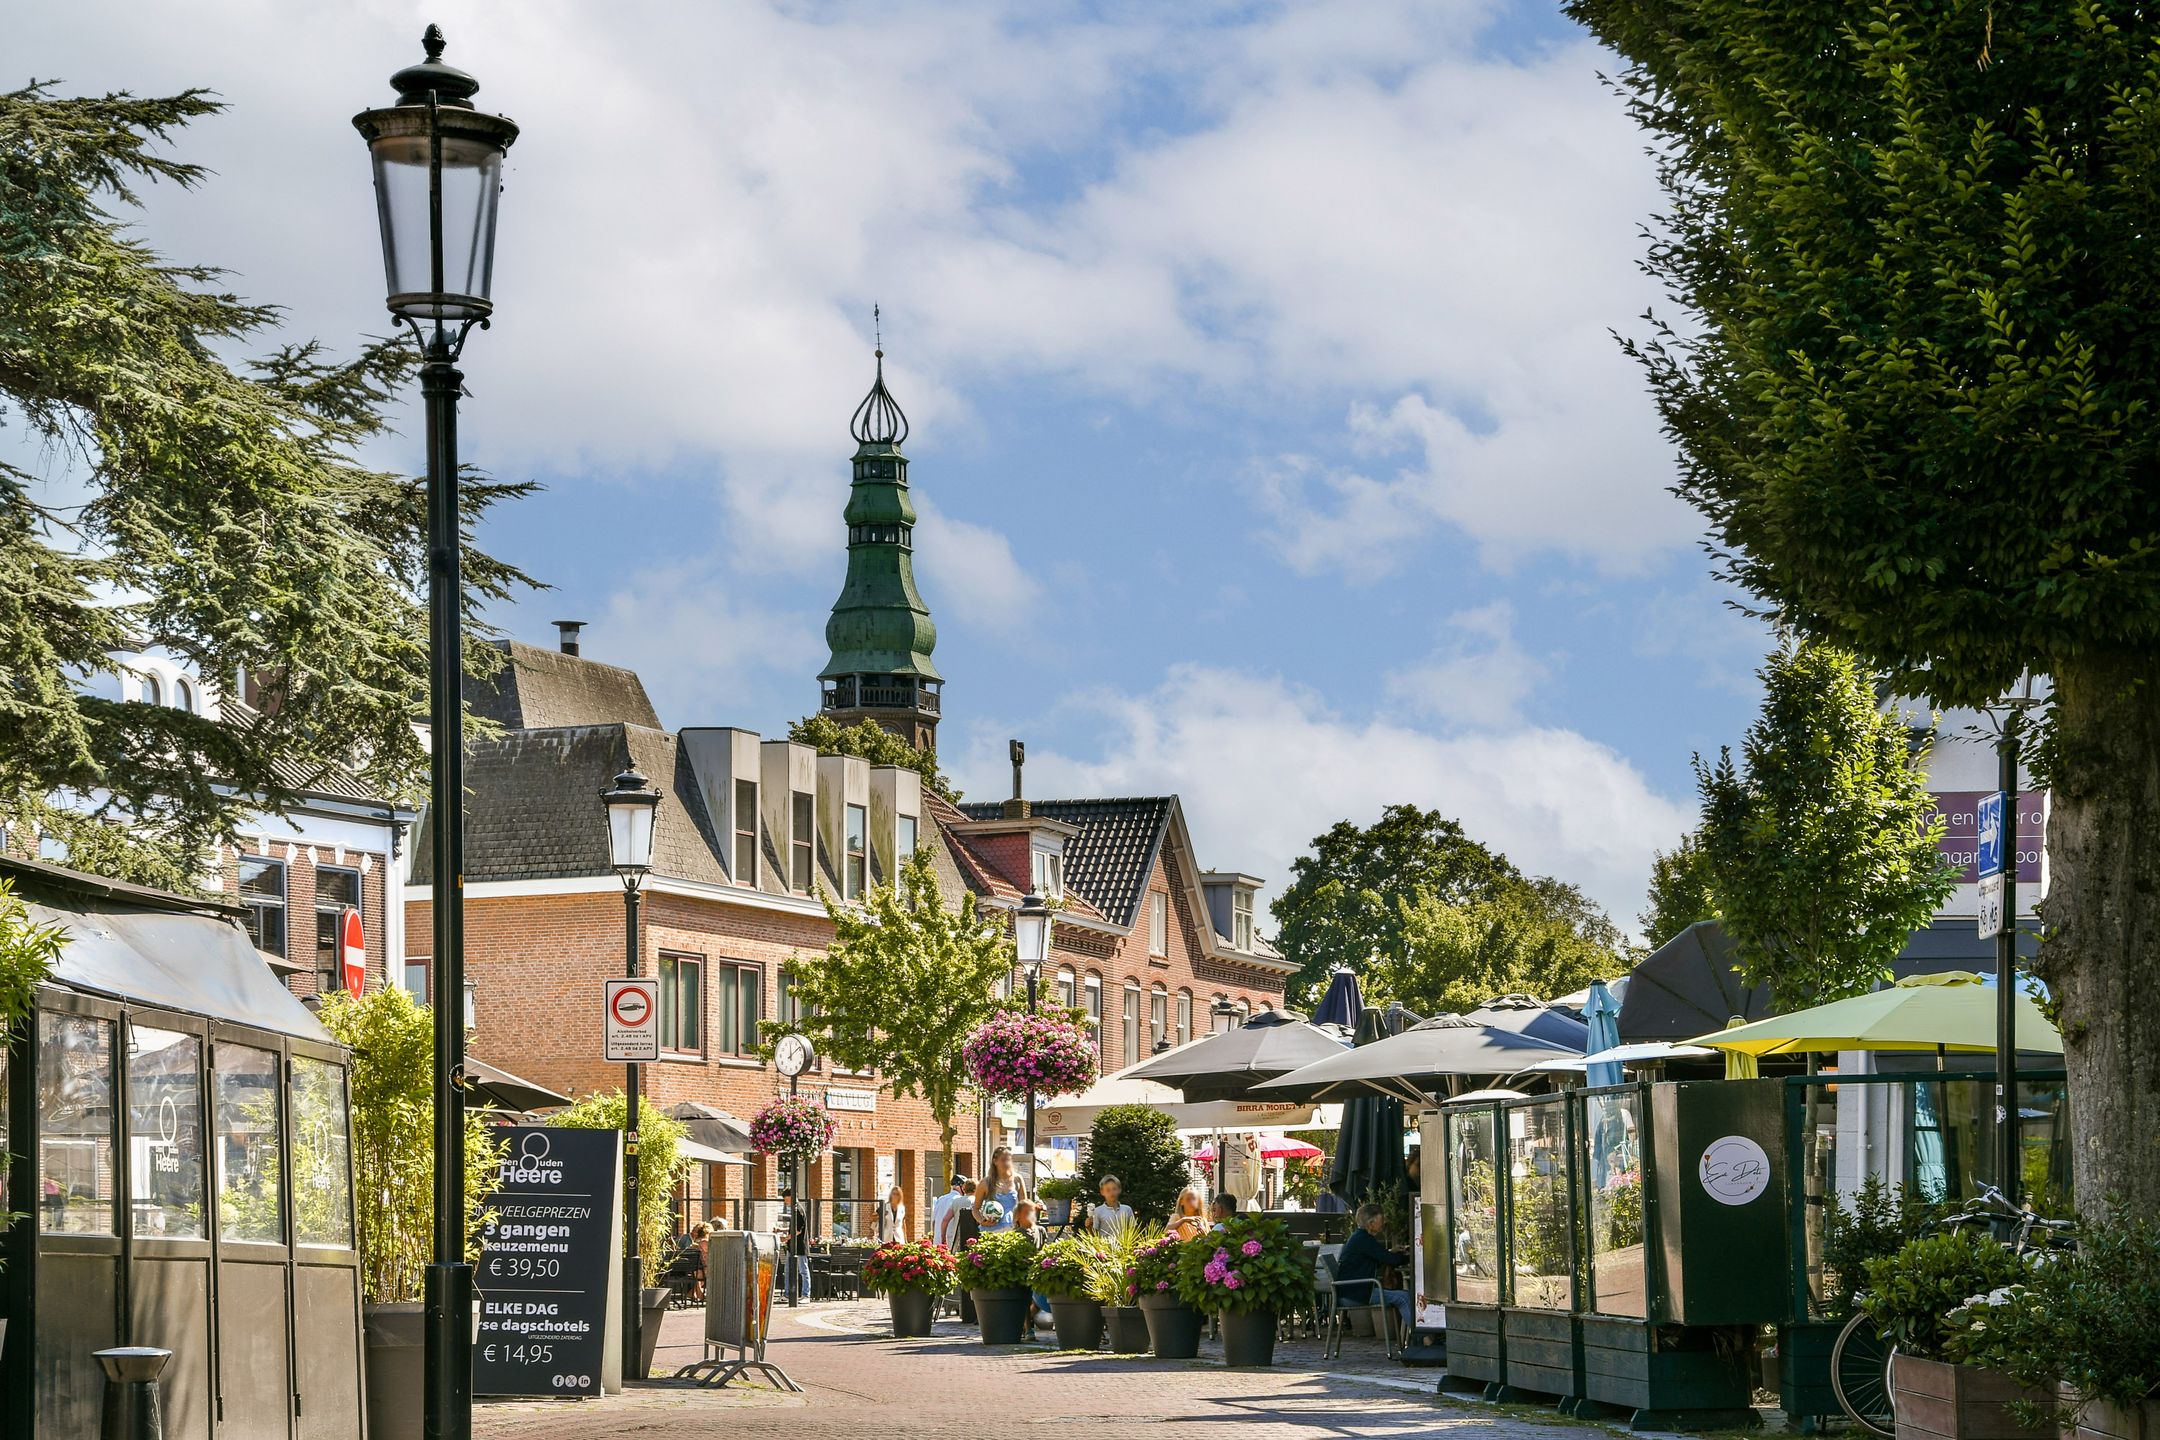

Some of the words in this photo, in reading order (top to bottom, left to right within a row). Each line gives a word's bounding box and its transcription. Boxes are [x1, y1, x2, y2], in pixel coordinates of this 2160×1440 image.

[1952, 813, 1974, 825] en
[156, 1153, 179, 1173] Heere
[500, 1166, 563, 1184] Heere
[499, 1205, 591, 1219] VEELGEPREZEN
[485, 1222, 496, 1236] 3
[500, 1224, 570, 1240] gangen
[483, 1239, 569, 1253] keuzemenu
[489, 1258, 502, 1276] €
[507, 1258, 560, 1280] 39,50
[485, 1302, 522, 1315] ELKE
[525, 1303, 558, 1315] DAG
[501, 1319, 590, 1333] dagschotels
[483, 1344, 497, 1362] €
[504, 1344, 553, 1365] 14,95
